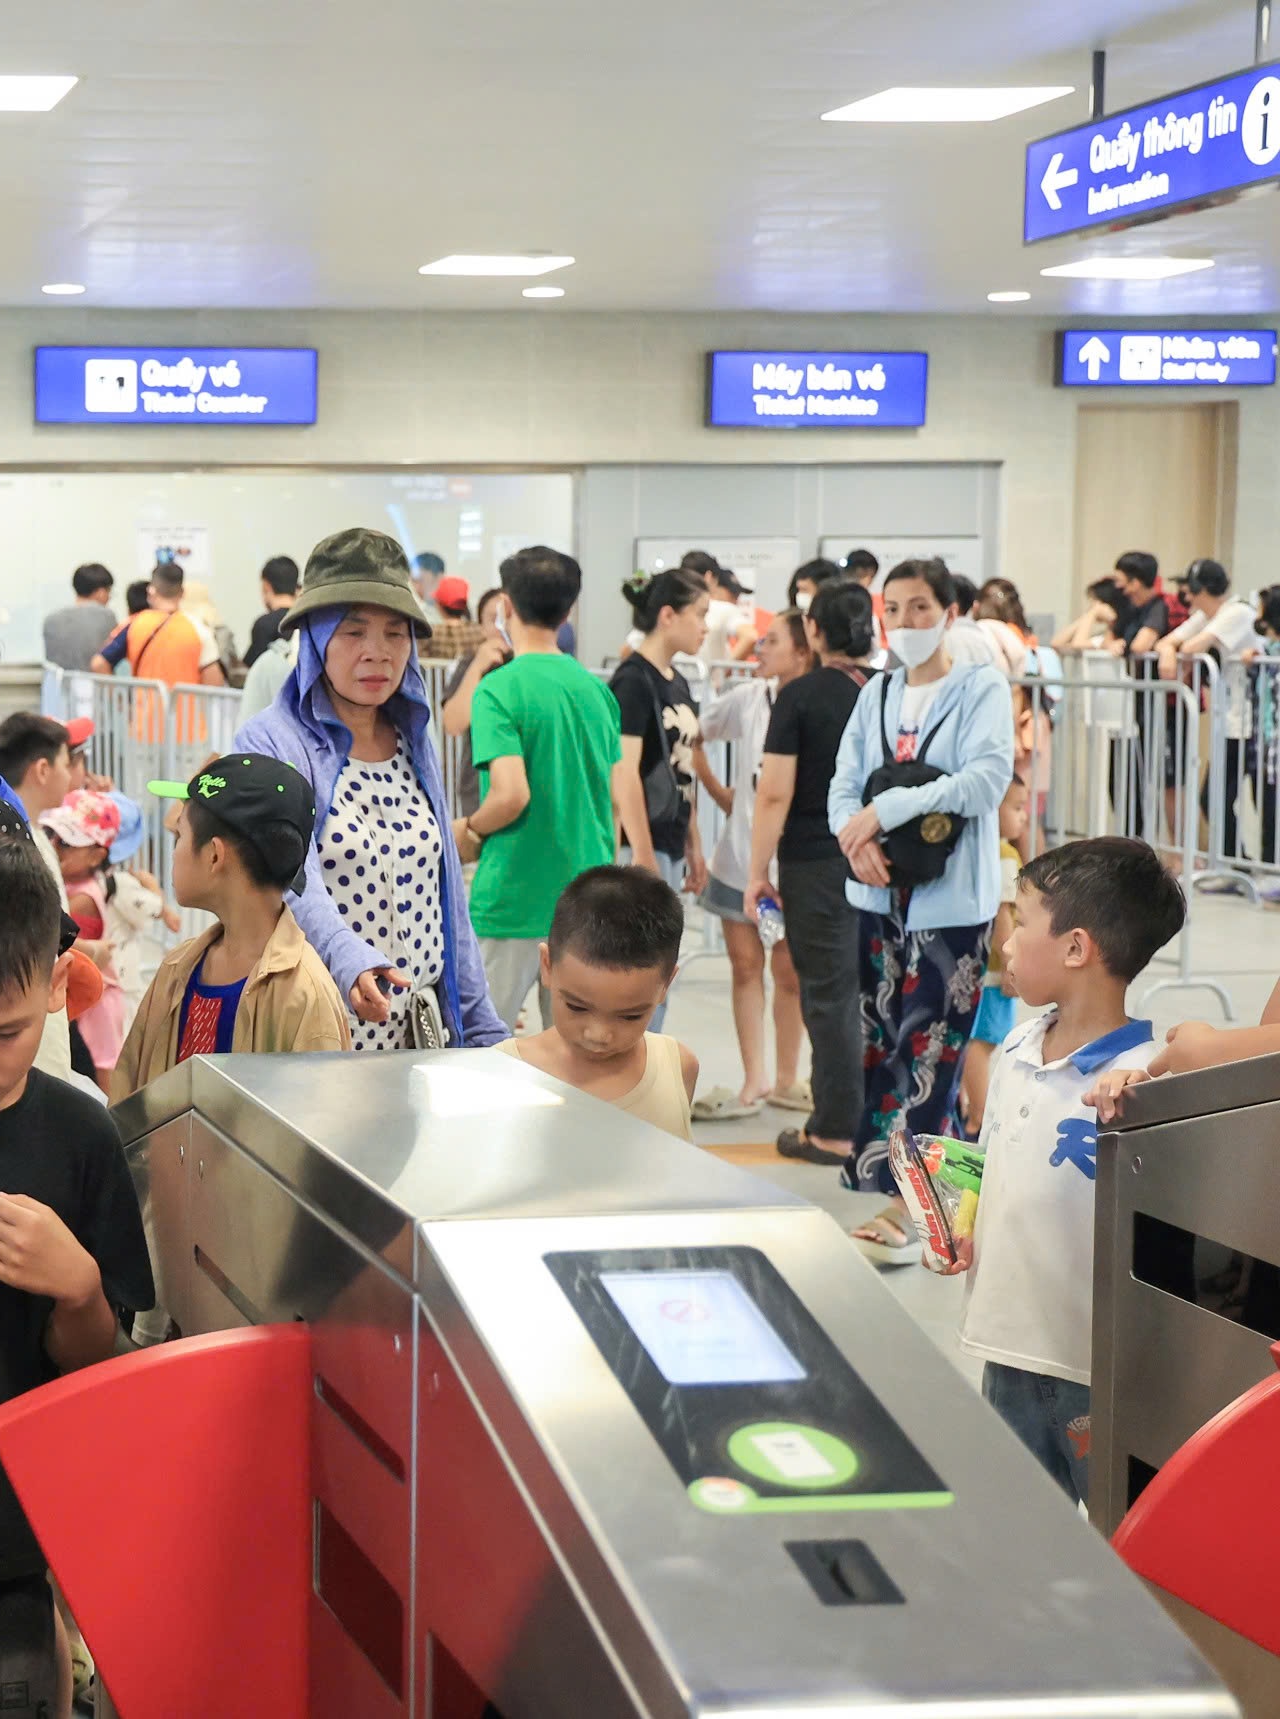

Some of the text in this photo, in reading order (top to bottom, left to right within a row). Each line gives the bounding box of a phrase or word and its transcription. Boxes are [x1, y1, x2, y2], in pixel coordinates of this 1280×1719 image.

[1143, 112, 1204, 158] thông
[1207, 95, 1238, 139] tin
[1088, 171, 1169, 215] Information
